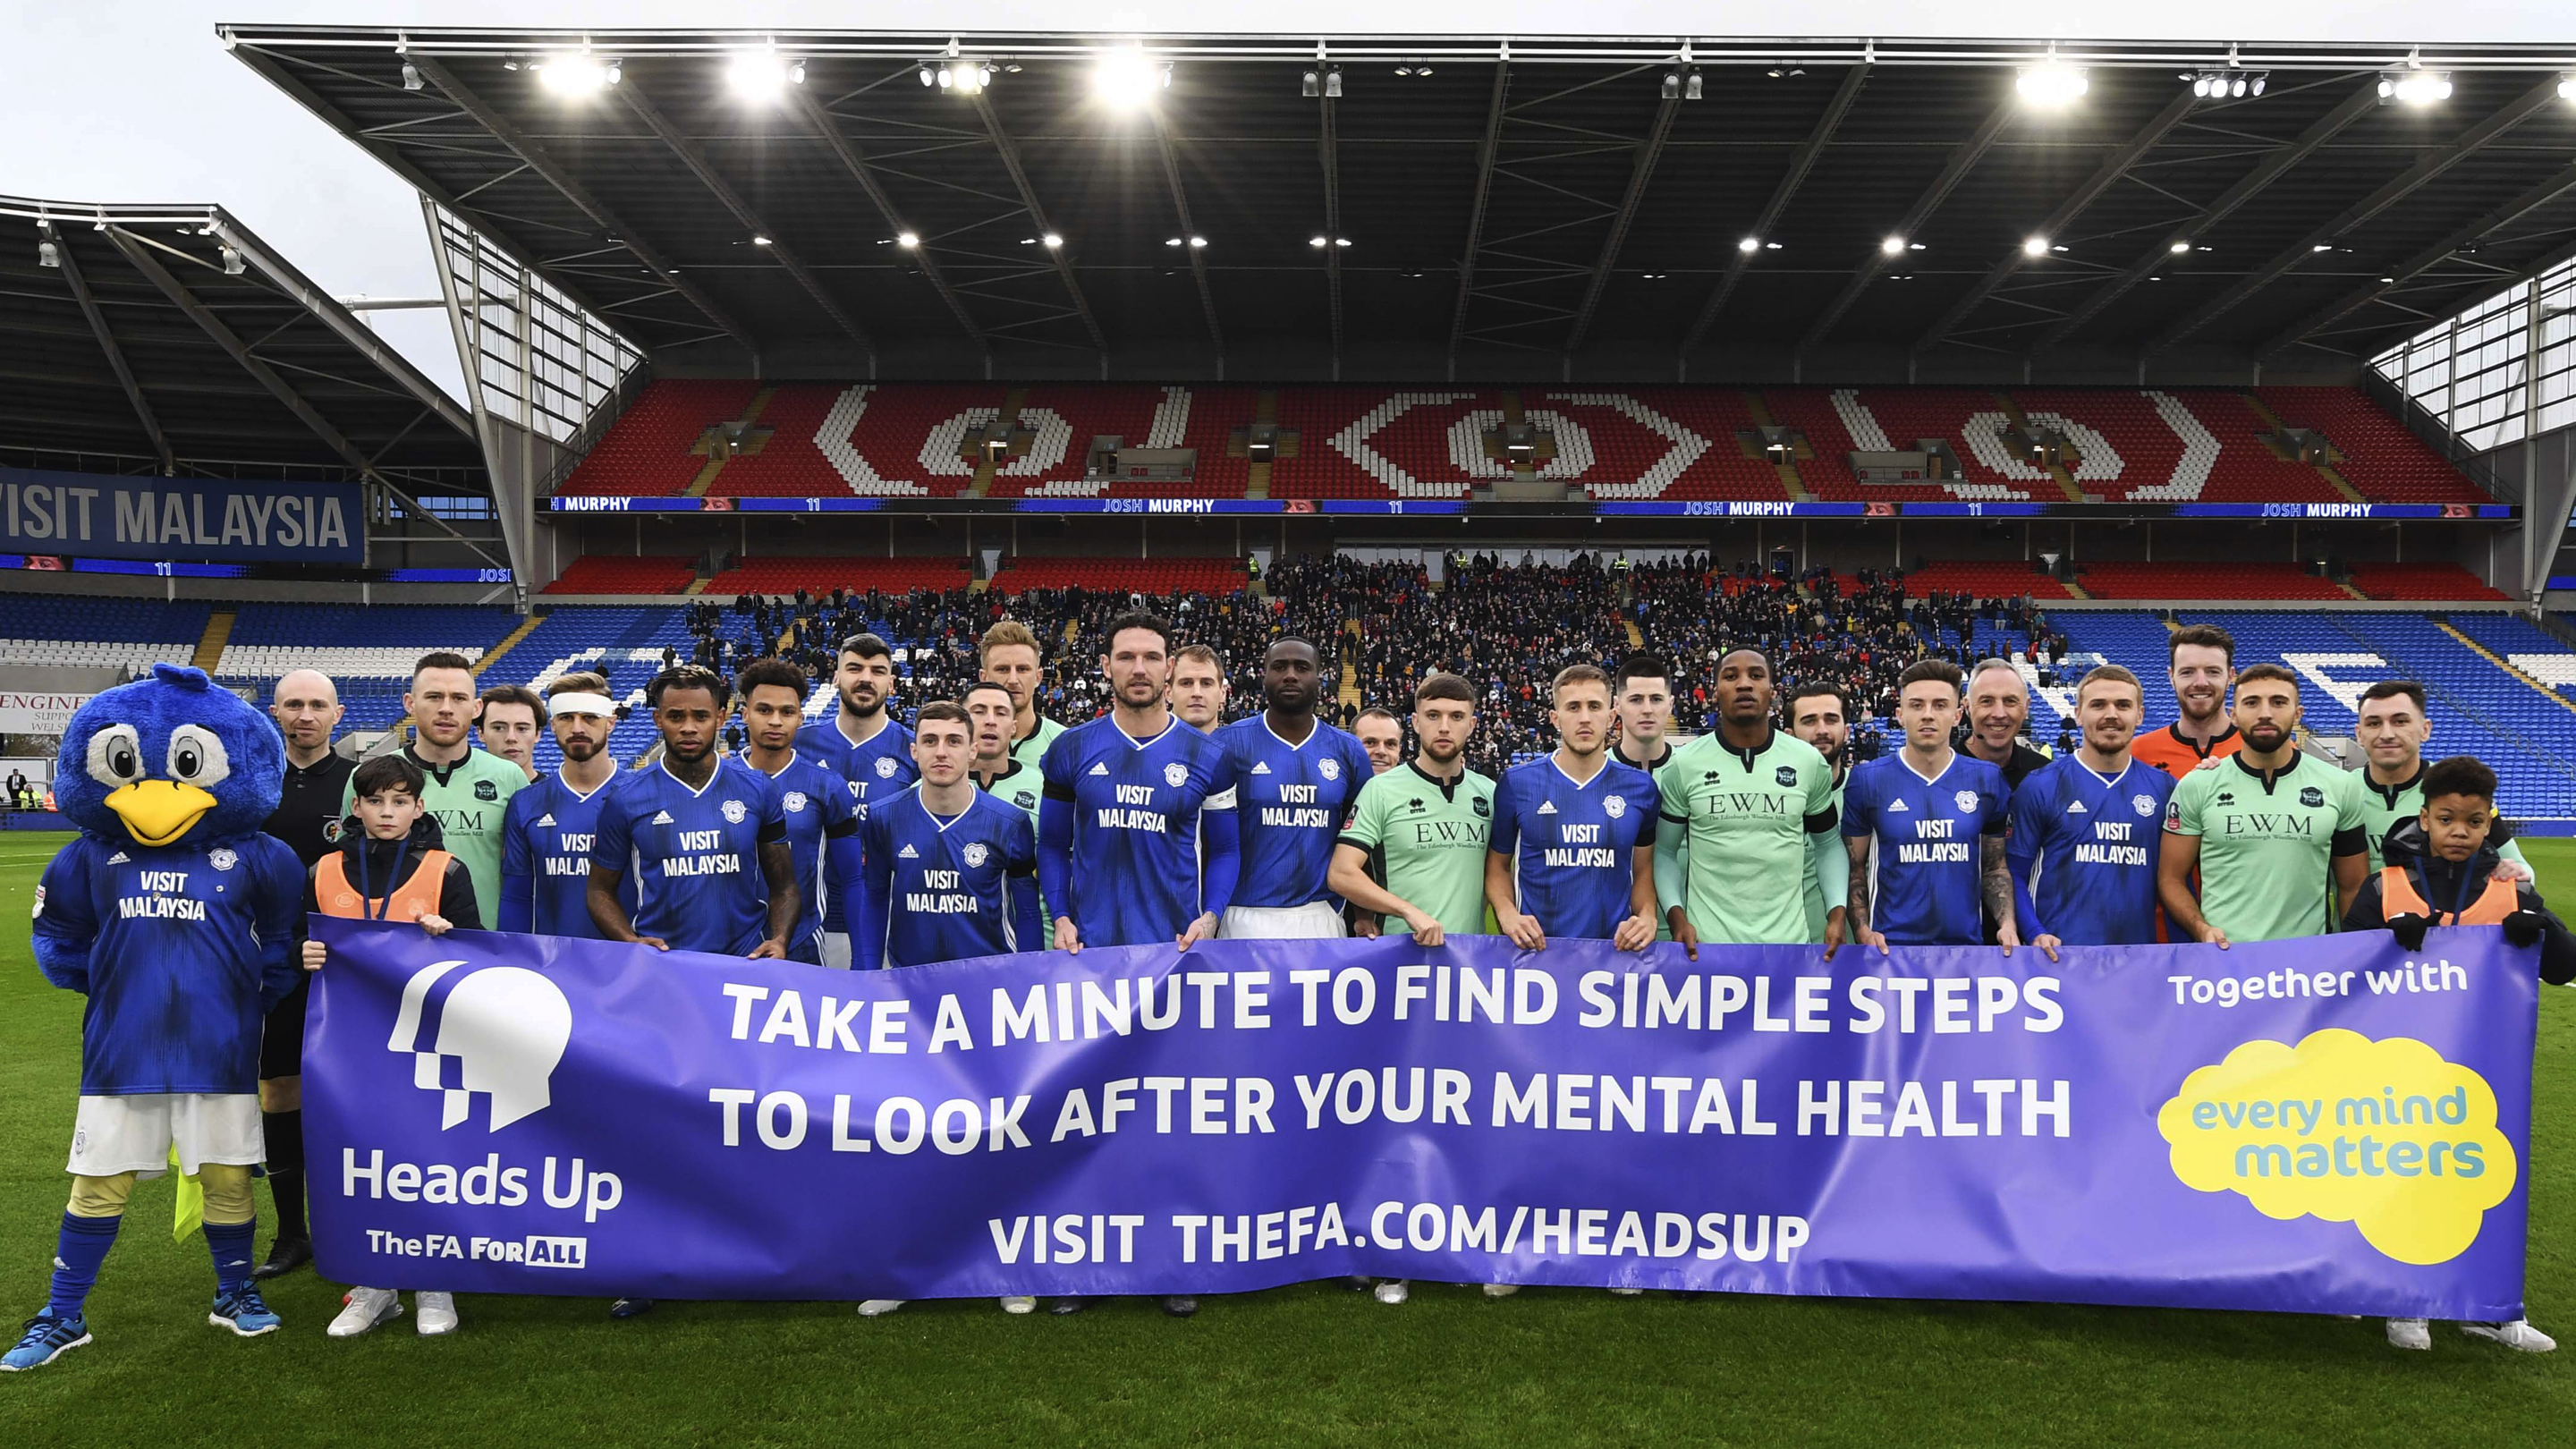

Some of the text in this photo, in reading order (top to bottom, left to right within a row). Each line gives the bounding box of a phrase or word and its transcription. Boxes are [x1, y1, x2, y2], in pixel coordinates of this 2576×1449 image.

[564, 496, 631, 511] MURPHY
[806, 497, 820, 512] 11
[1103, 499, 1214, 513] JOSH MURPHY
[1388, 501, 1402, 514] 11
[1683, 502, 1795, 516] JOSH MURPHY
[1968, 503, 1982, 516] 11
[2261, 504, 2372, 517] JOSH MURPHY
[0, 483, 349, 547] ISIT MALAYSIA
[155, 563, 172, 576] 11
[0, 695, 92, 709] ENGINE
[34, 712, 74, 720] SUPPO
[31, 723, 68, 732] WELS
[1116, 784, 1155, 806] VISIT
[1279, 784, 1318, 803] VISIT
[1708, 792, 1787, 815] EWM
[1097, 809, 1166, 834] MALAYSIA
[1262, 808, 1329, 827] MALAYSIA
[2225, 814, 2314, 835] EWM
[1415, 821, 1486, 843] EWM
[1561, 825, 1600, 843] VISIT
[1915, 819, 1954, 838] VISIT
[2095, 821, 2132, 841] VISIT
[679, 830, 721, 851] VISIT
[1545, 849, 1614, 868] MALAYSIA
[1899, 843, 1969, 863] MALAYSIA
[2075, 844, 2147, 866] MALAYSIA
[546, 858, 590, 876] MALAY
[663, 854, 741, 877] MALAYSIA
[140, 871, 188, 893] VISIT
[924, 869, 961, 889] VISIT
[119, 898, 205, 921] MALAYSIA
[906, 893, 978, 913] MALAYSIA
[2168, 960, 2468, 1007] Together with
[723, 965, 2064, 1054] TAKE A MINUTE TO FIND SIMPLE STEPS
[708, 1067, 2071, 1155] TO LOOK AFTER YOUR MENTAL HEALTH
[2191, 1086, 2467, 1136] every mind
[2234, 1135, 2486, 1178] matters
[343, 1148, 623, 1223] Heads Up
[989, 1201, 1810, 1264] VISIT THEFA.COM/HEADSUP
